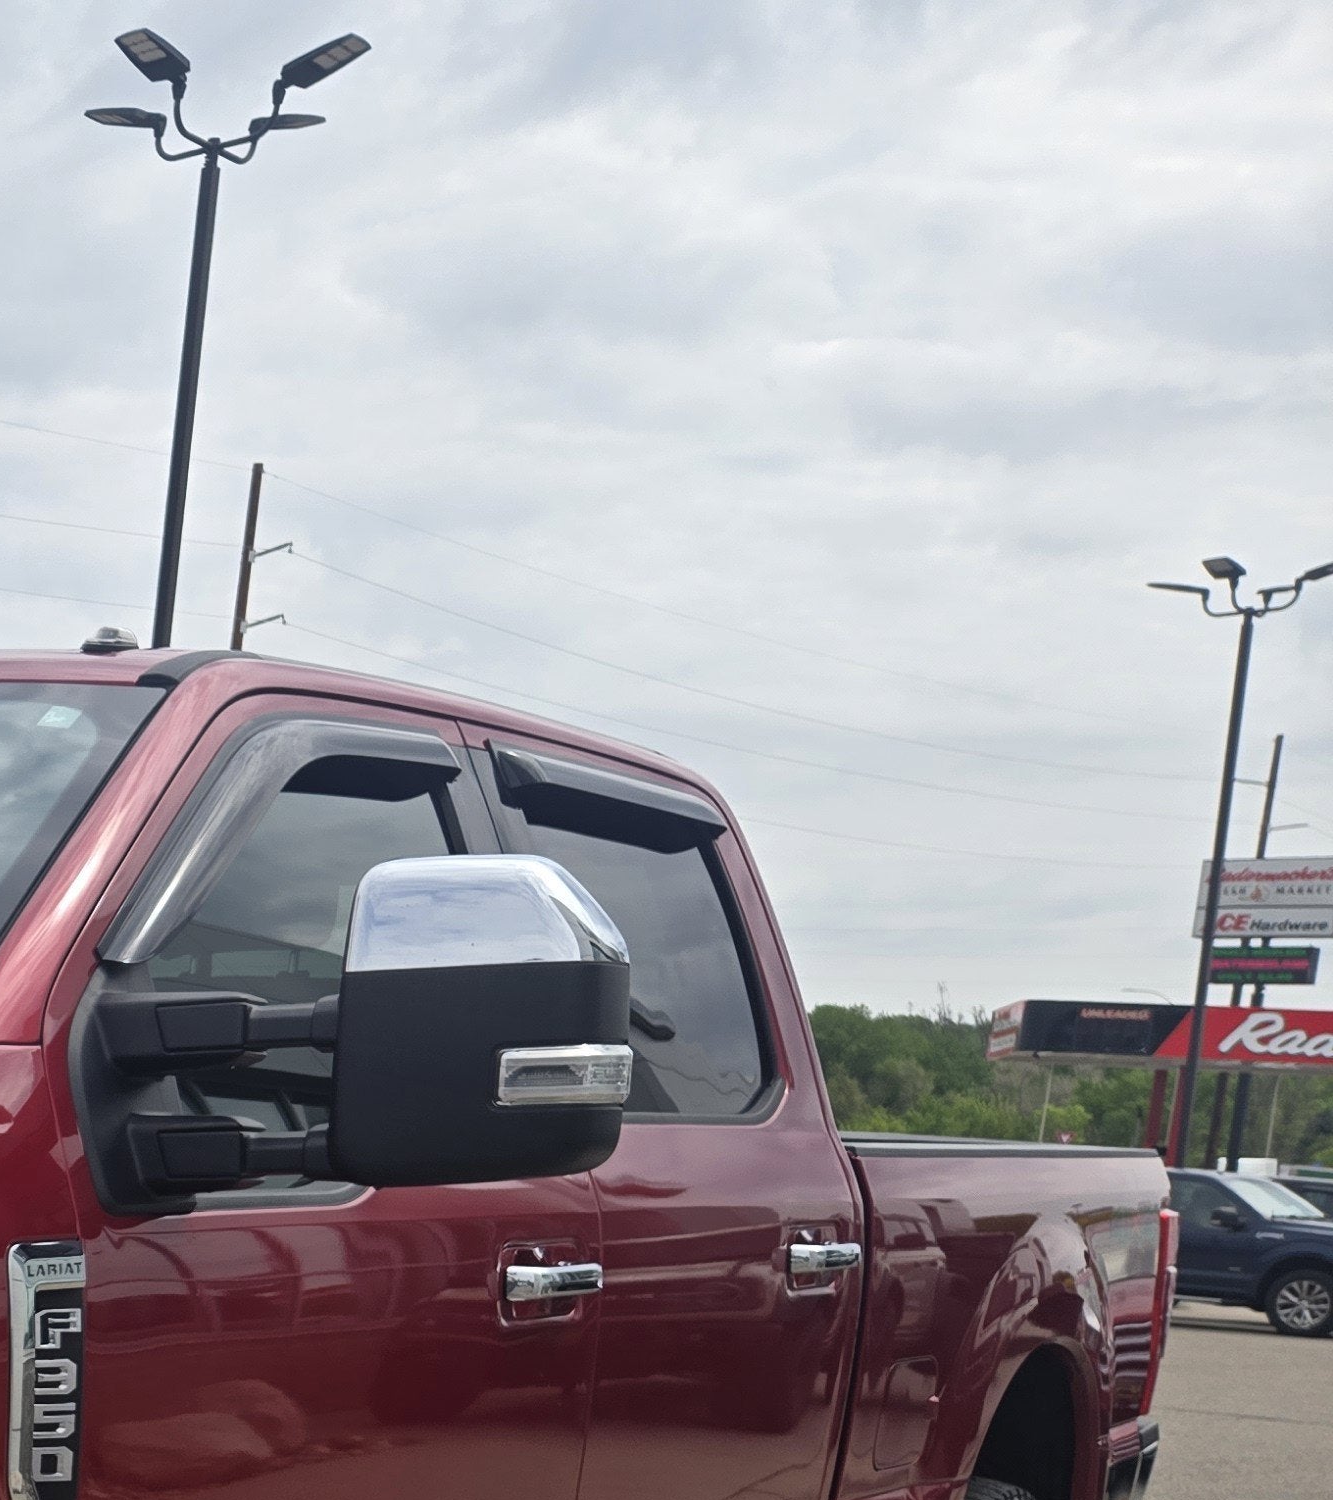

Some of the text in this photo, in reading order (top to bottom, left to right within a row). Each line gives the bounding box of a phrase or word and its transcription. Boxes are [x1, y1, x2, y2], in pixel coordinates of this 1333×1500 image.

[1249, 919, 1329, 931] Hardware
[26, 1262, 82, 1278] LARIAT
[32, 1308, 82, 1482] F350
